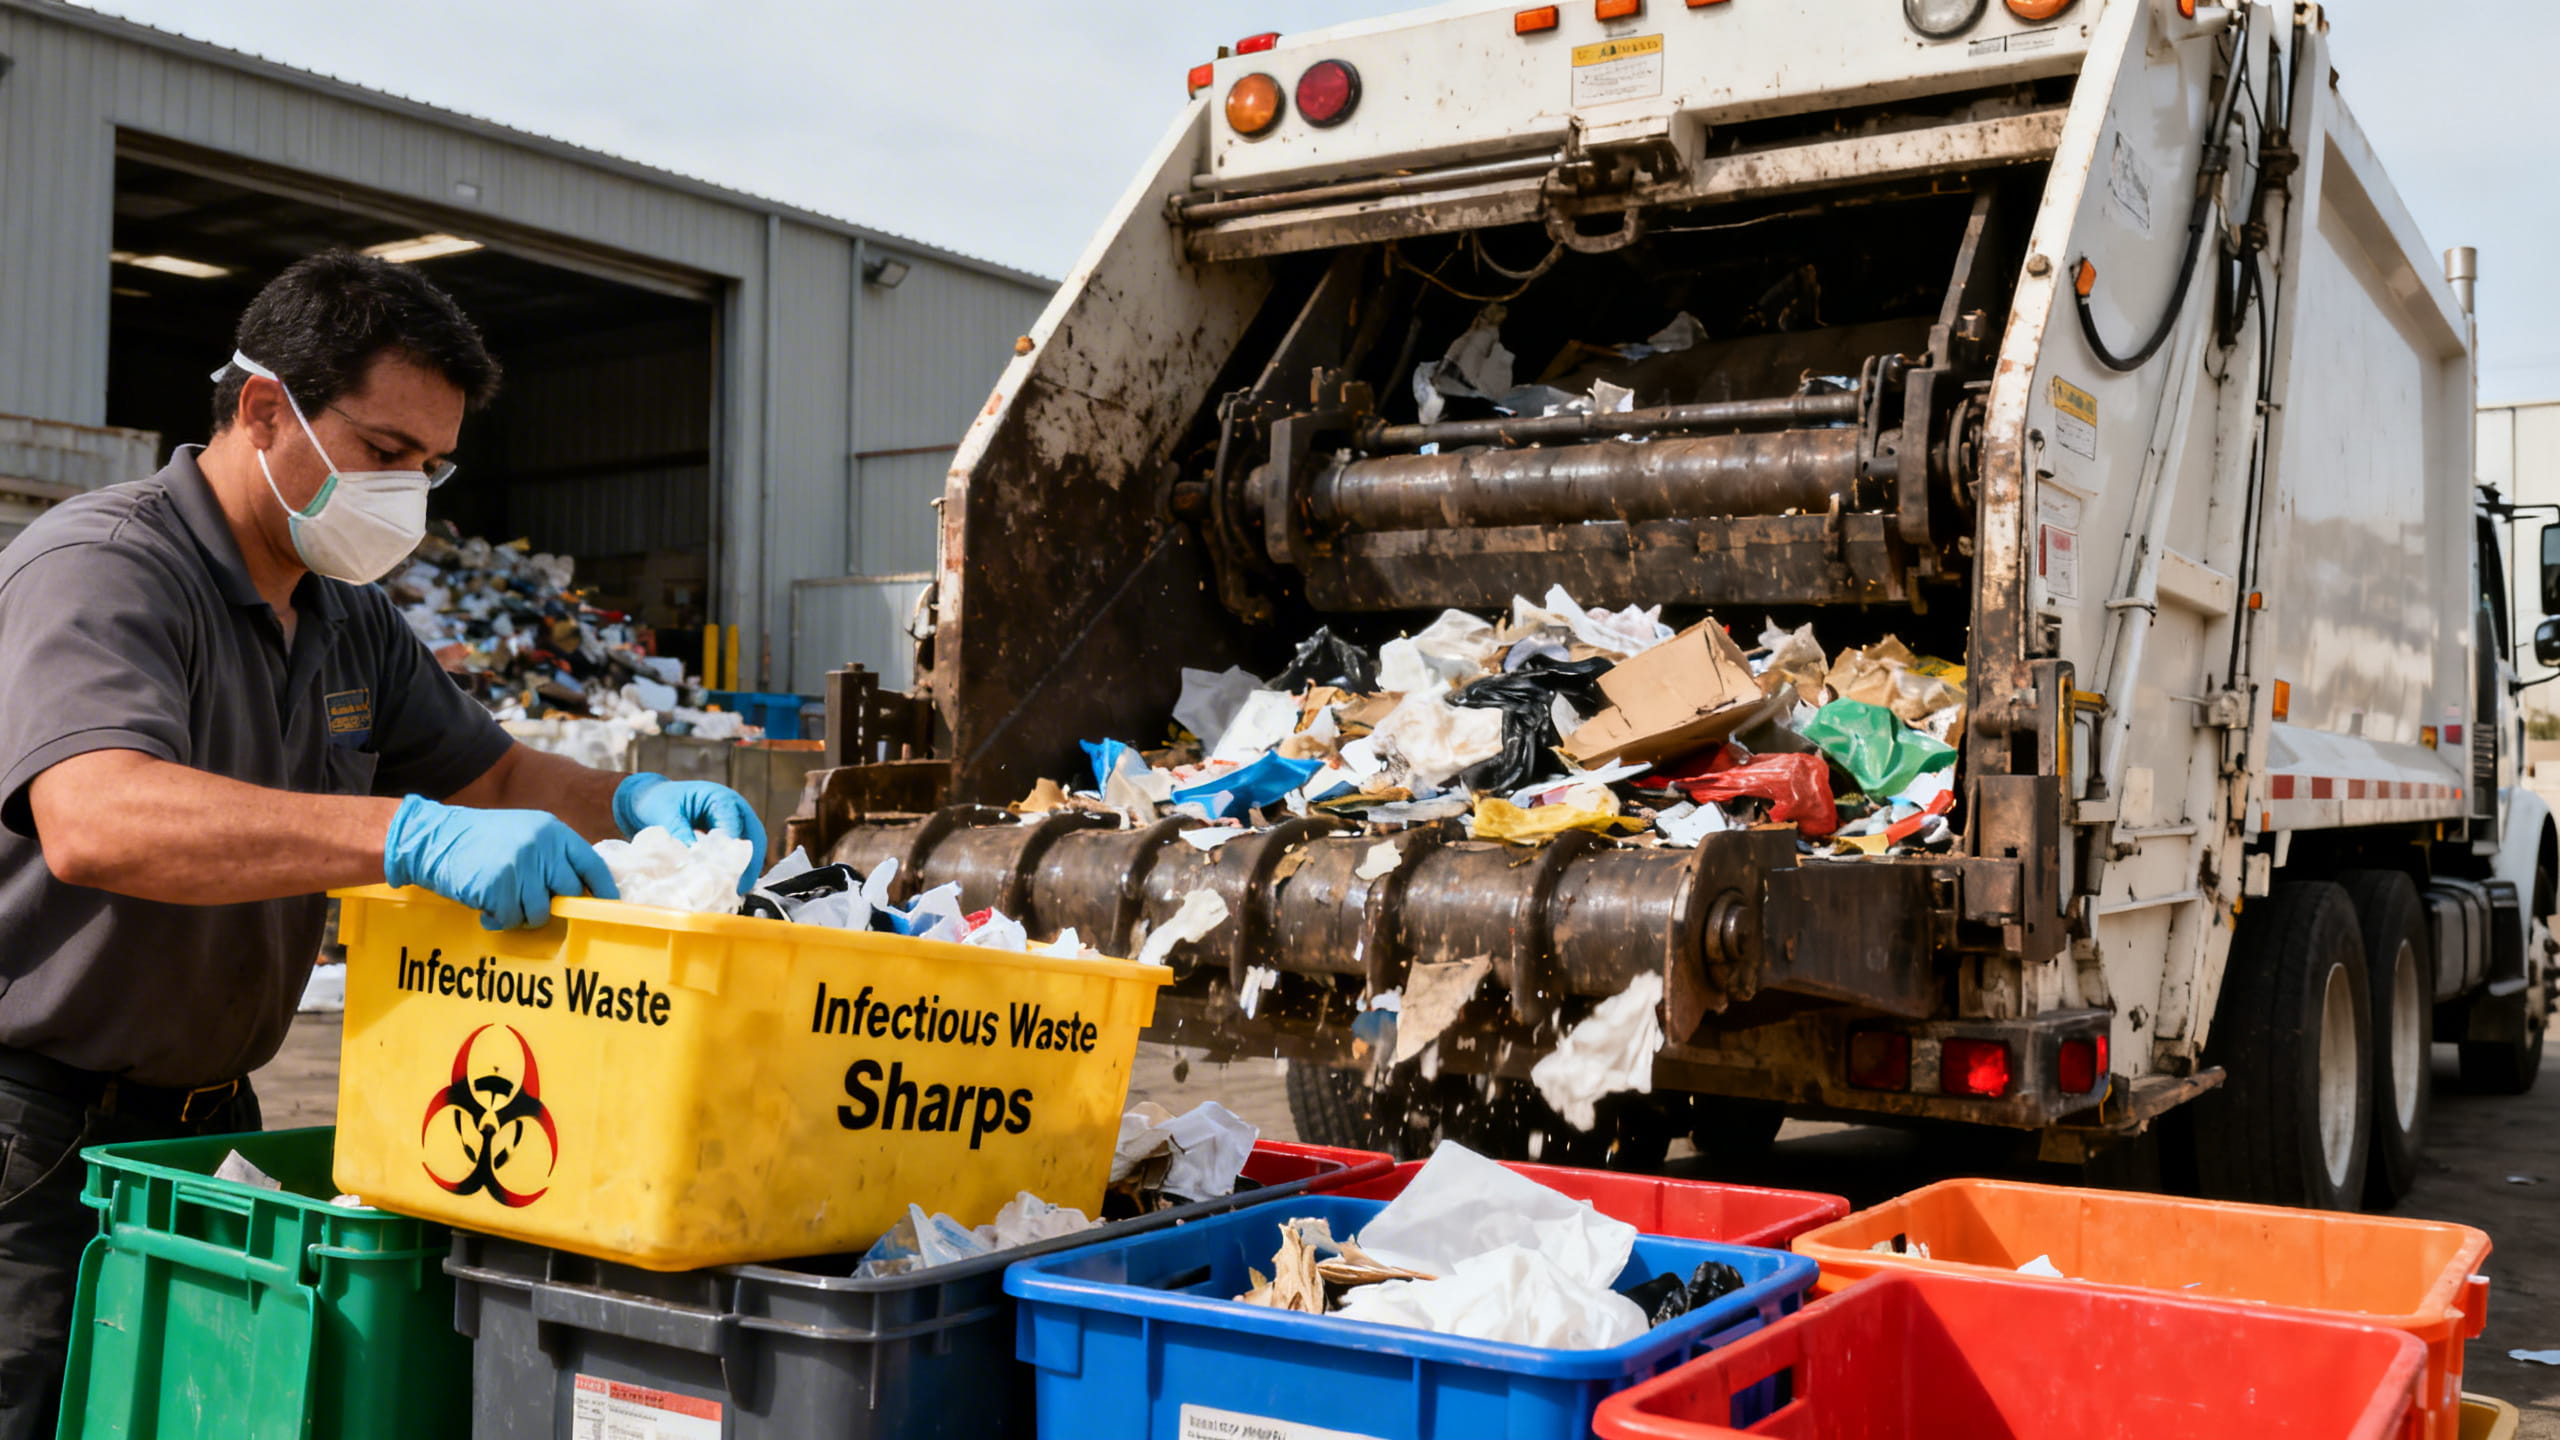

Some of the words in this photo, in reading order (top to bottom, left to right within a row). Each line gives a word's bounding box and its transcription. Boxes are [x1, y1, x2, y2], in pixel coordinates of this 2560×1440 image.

[398, 946, 553, 1009] Infectious
[565, 967, 671, 1026] Waste
[811, 982, 1000, 1047] Infectious
[1009, 1002, 1098, 1054] Waste
[837, 1059, 1034, 1150] Sharps
